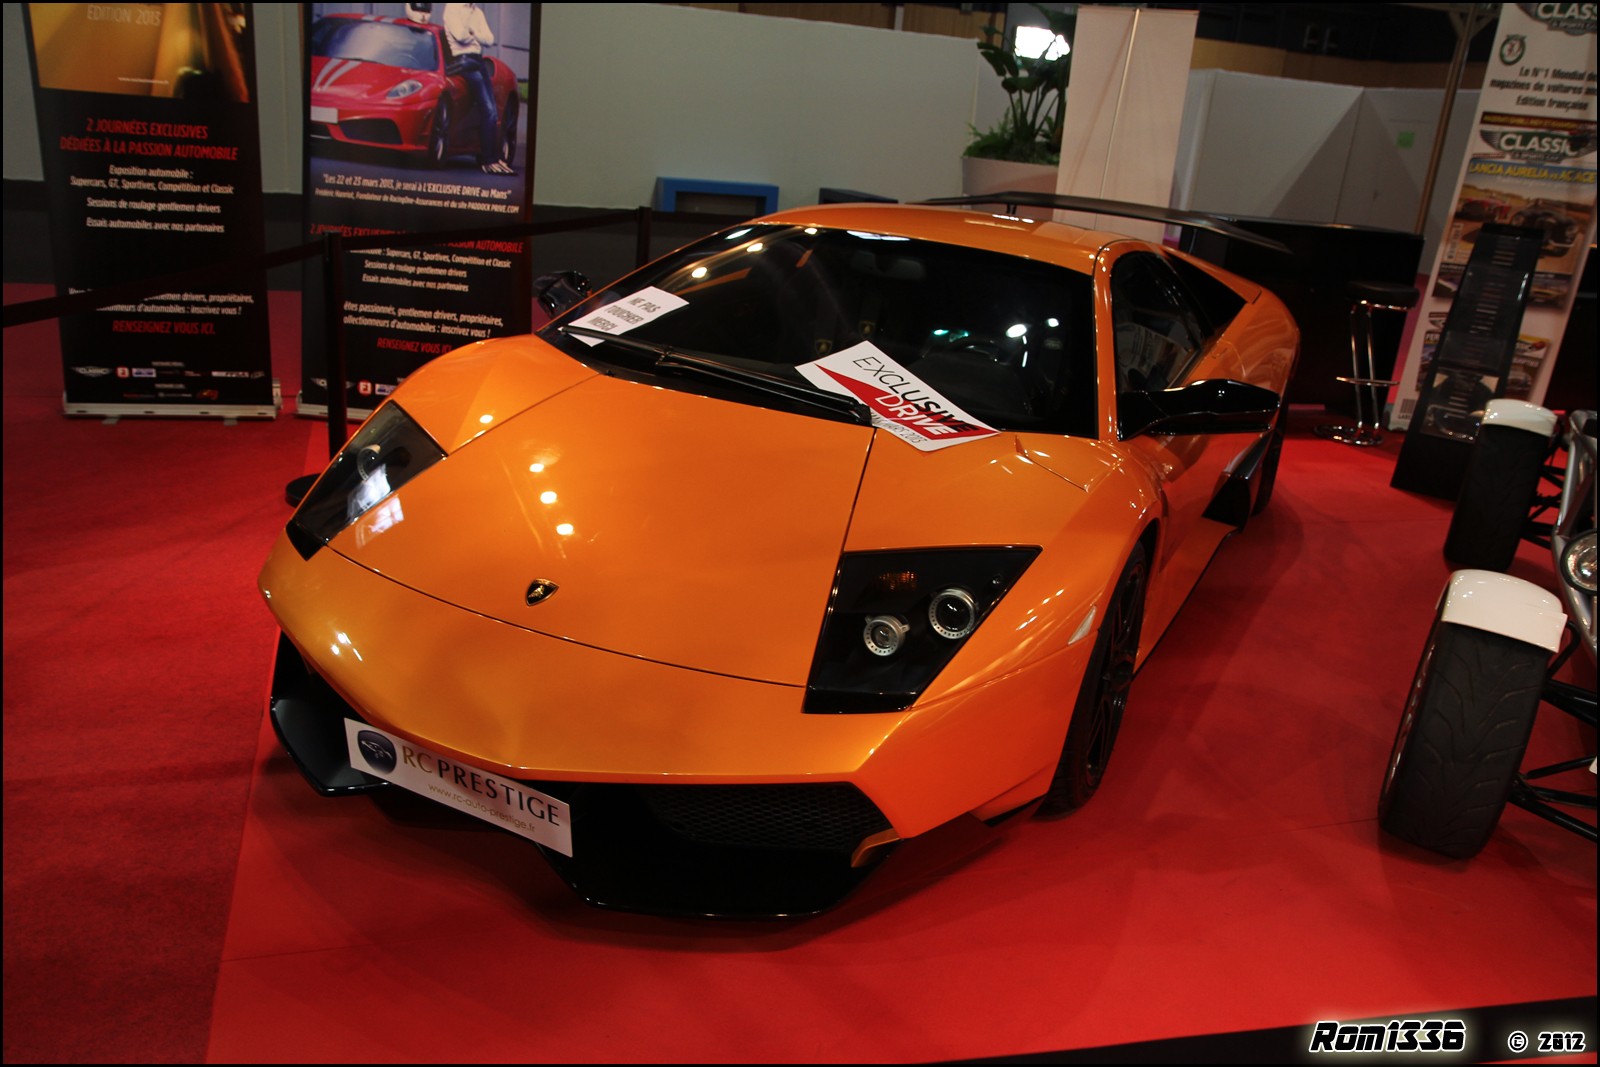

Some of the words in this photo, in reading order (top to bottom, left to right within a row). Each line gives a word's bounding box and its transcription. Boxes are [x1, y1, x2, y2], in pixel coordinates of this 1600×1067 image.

[87, 4, 131, 23] EDITION
[136, 9, 161, 26] 2013
[1519, 66, 1530, 77] Le
[1552, 69, 1586, 80] Mondial
[1490, 78, 1531, 89] magazines
[1533, 82, 1544, 91] de
[1547, 84, 1583, 94] voitures
[1516, 95, 1546, 106] Edition
[1547, 98, 1589, 112] française
[86, 117, 94, 131] 2
[96, 118, 148, 135] JOURNÉES
[150, 121, 208, 139] EXCLUSIVES
[60, 134, 102, 152] DÉDIÉES
[103, 136, 111, 153] À
[113, 140, 126, 154] LA
[128, 140, 172, 156] PASSION
[174, 144, 239, 160] AUTOMOBILE
[1500, 133, 1578, 156] CLASSIC
[109, 165, 147, 176] Exposition
[148, 169, 189, 178] automobile
[1469, 162, 1504, 174] LANCIA
[1505, 165, 1549, 178] AURELIA
[1560, 170, 1572, 181] AC
[1575, 171, 1596, 184] ACE
[70, 176, 108, 188] Supercars,
[121, 179, 157, 192] Sportives,
[158, 181, 201, 193] Compétition
[202, 184, 210, 193] et
[211, 184, 234, 194] Classic
[336, 174, 344, 185] 22
[345, 176, 352, 185] et
[353, 176, 361, 186] 23
[362, 178, 378, 188] mars
[394, 179, 402, 191] je
[402, 182, 417, 191] serai
[462, 186, 481, 197] DRIVE
[481, 189, 489, 197] au
[86, 197, 117, 208] Sessions
[118, 199, 128, 208] de
[128, 200, 156, 211] roulage
[157, 202, 195, 212] gentlemen
[196, 203, 221, 213] drivers
[382, 194, 389, 202] de
[450, 200, 457, 208] du
[457, 201, 467, 209] site
[86, 216, 108, 227] Essais
[109, 219, 153, 230] automobiles
[154, 222, 170, 230] avec
[171, 223, 184, 231] nos
[184, 223, 225, 233] partenaires
[310, 224, 317, 235] 2
[475, 239, 524, 253] AUTOMOBILE
[386, 247, 412, 260] Supercars,
[423, 251, 451, 263] Sportives,
[451, 253, 485, 266] Compétition
[485, 258, 492, 266] et
[492, 258, 512, 268] Classic
[364, 259, 388, 270] Sessions
[388, 262, 395, 270] de
[395, 264, 416, 274] roulage
[416, 266, 447, 276] gentlemen
[447, 268, 467, 278] drivers
[362, 273, 379, 282] Essais
[380, 276, 412, 286] automobiles
[412, 280, 425, 288] avec
[425, 281, 437, 289] nos
[437, 282, 469, 292] partenaires
[181, 292, 208, 302] drivers,
[208, 293, 255, 304] propriétaires,
[628, 297, 646, 306] NE
[638, 301, 661, 313] PAS
[137, 303, 186, 314] d'automobiles
[190, 305, 220, 315] inscrivez
[221, 307, 237, 315] vous
[343, 300, 358, 311] êtes
[358, 302, 396, 315] passionnés,
[397, 307, 433, 318] gentlemen
[433, 310, 458, 322] drivers,
[459, 314, 503, 327] propriétaires,
[604, 305, 645, 325] TOUCHER
[112, 320, 171, 333] RENSEIGNEZ
[173, 321, 199, 335] VOUS
[343, 314, 390, 328] ollectionneurs
[390, 318, 436, 333] d'automobiles
[441, 324, 469, 336] inscrivez
[470, 329, 487, 338] vous
[587, 316, 618, 331] MERCI
[377, 337, 419, 353] RENSEIGNEZ
[421, 342, 441, 354] VOUS
[852, 356, 980, 433] EXCLUSIVE
[874, 393, 957, 436] DRIVE
[402, 745, 432, 774] RC
[437, 759, 560, 827] PRESTIGE
[428, 782, 536, 832] www.rc-auto-prestige.fr
